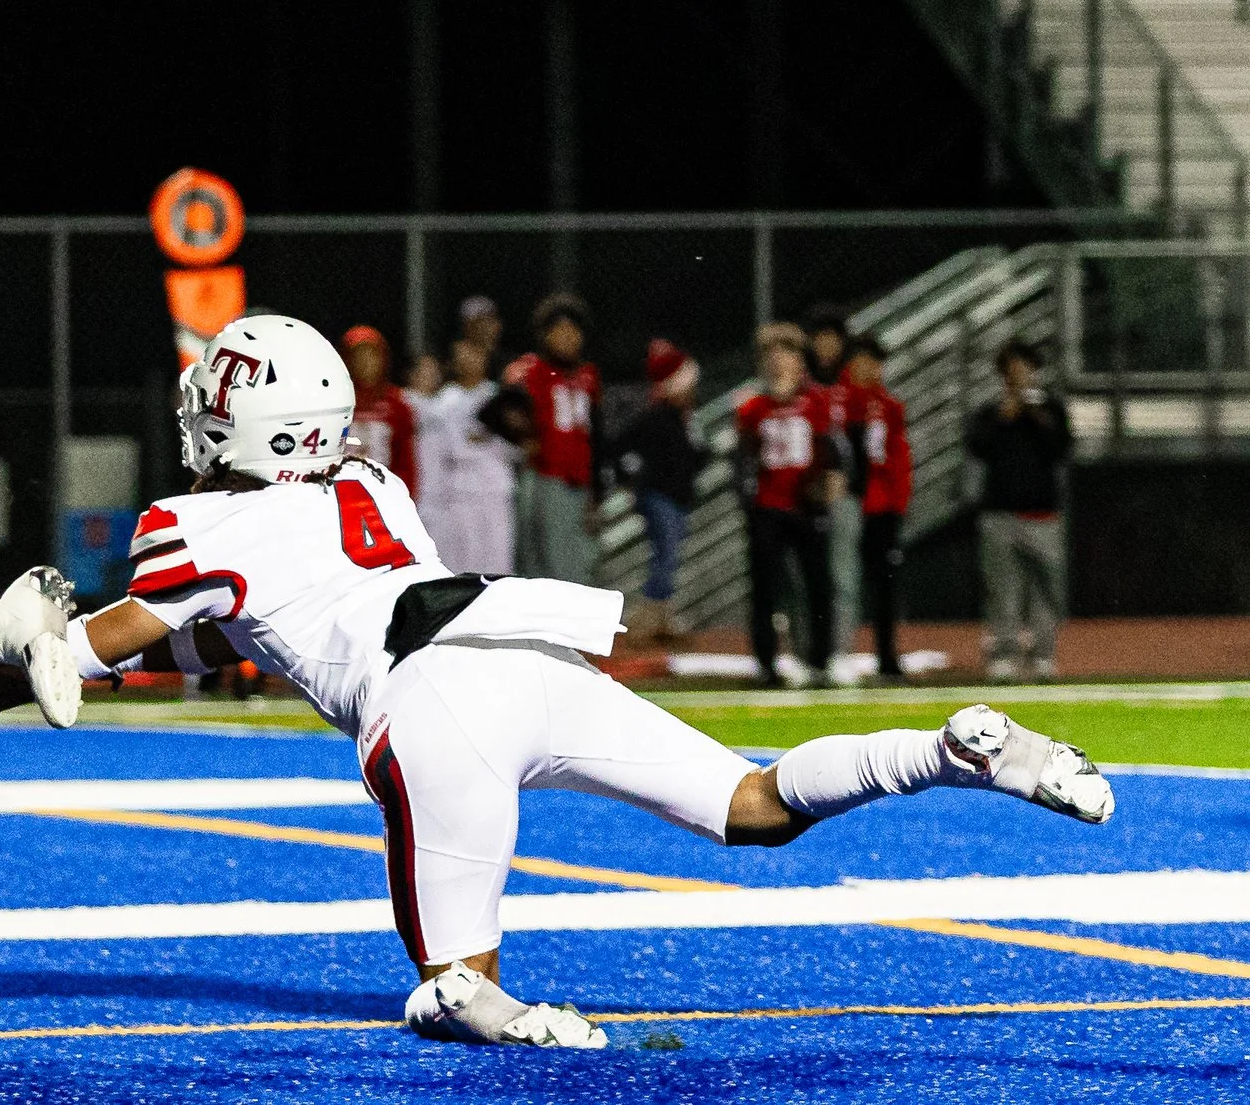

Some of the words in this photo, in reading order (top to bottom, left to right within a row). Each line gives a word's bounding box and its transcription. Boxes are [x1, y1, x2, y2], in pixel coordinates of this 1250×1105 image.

[210, 347, 263, 428] T
[302, 427, 321, 455] 4
[334, 479, 418, 570] 4
